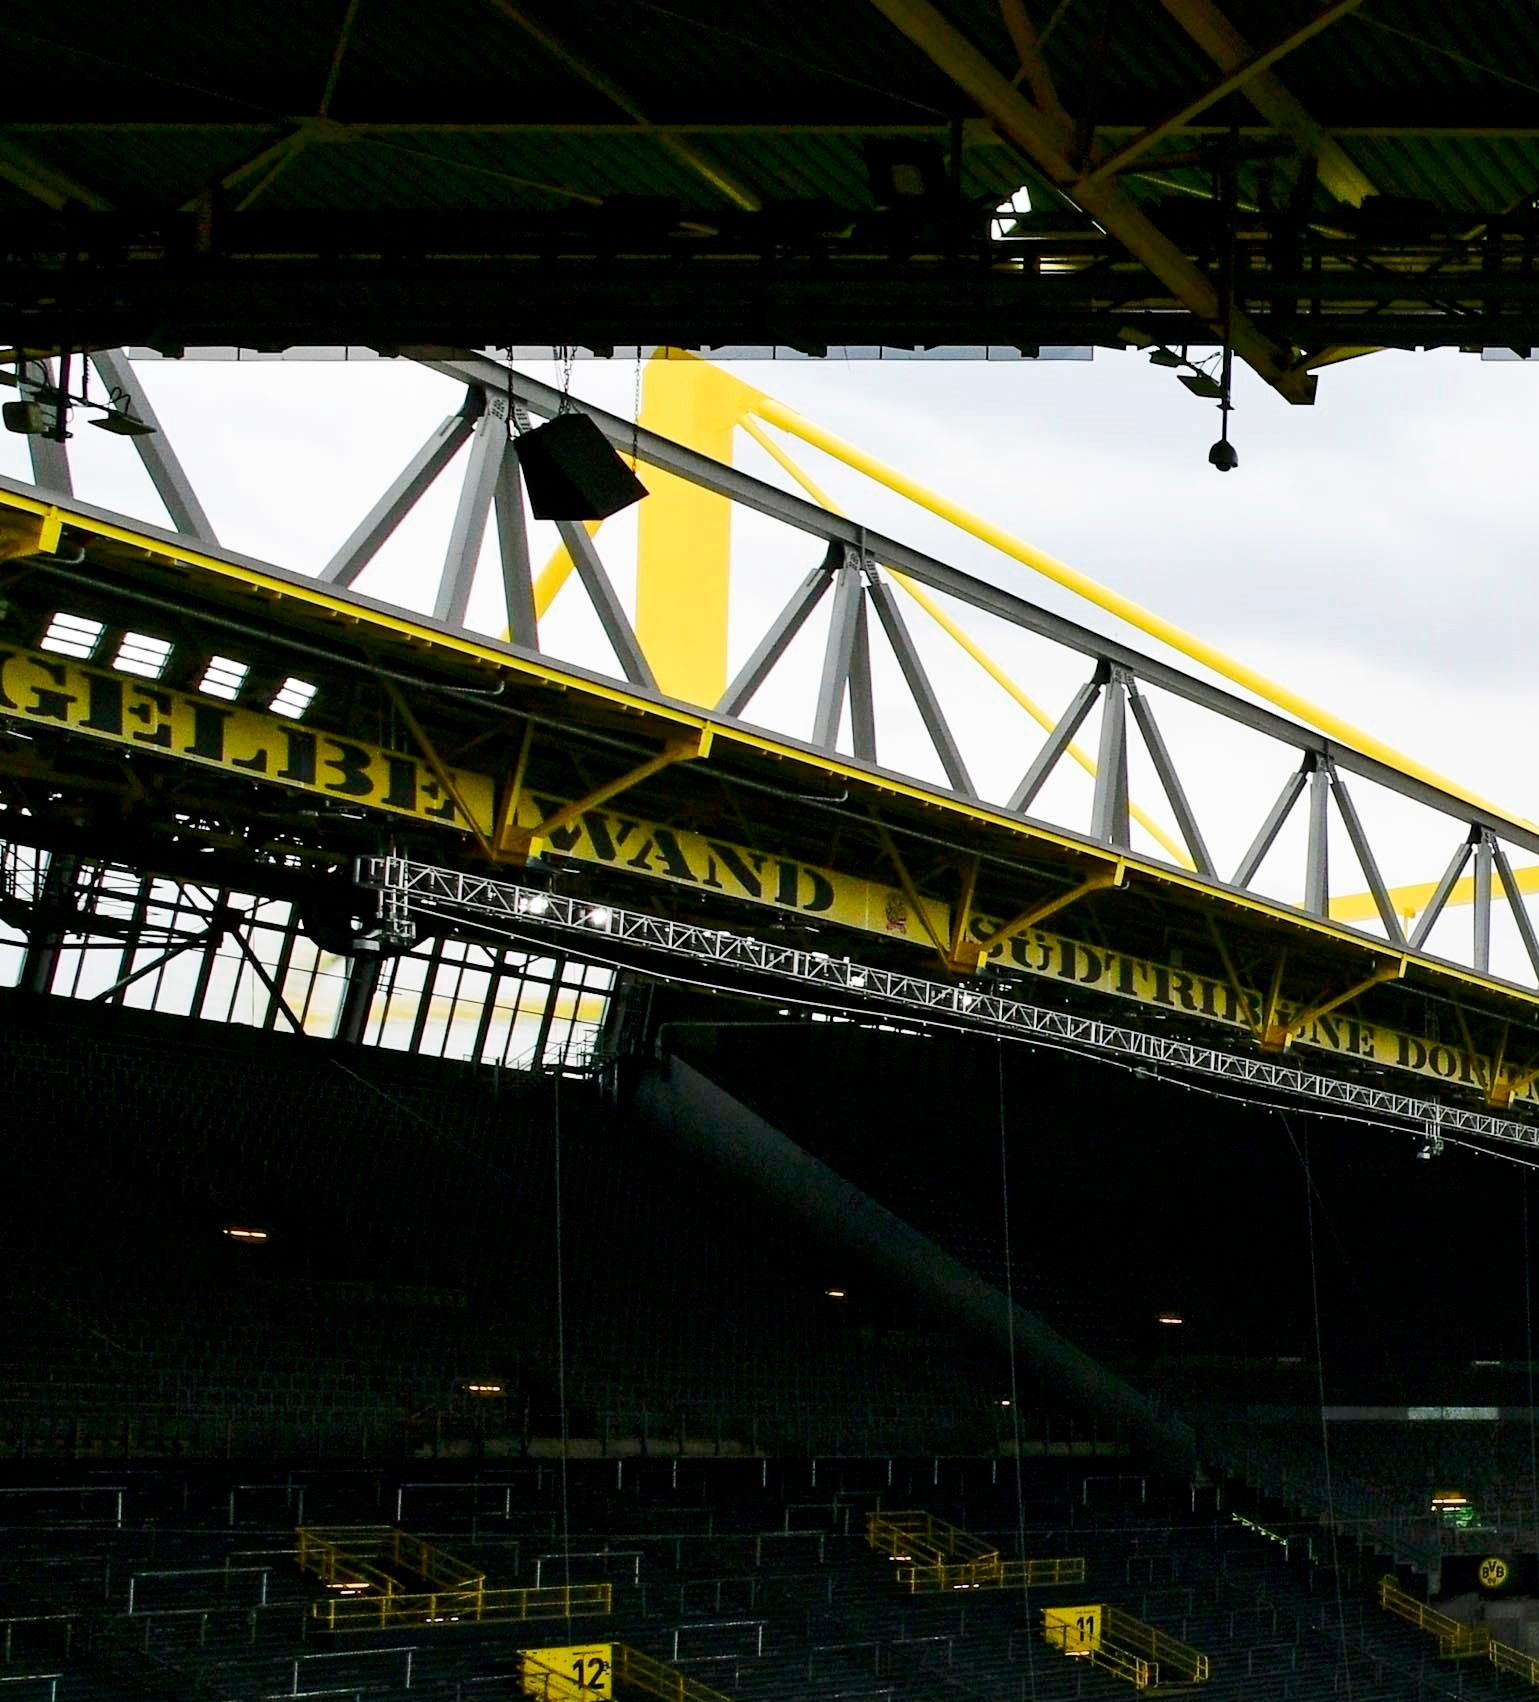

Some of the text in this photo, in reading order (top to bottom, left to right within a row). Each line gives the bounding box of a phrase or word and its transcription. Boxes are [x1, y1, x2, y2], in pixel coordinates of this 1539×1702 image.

[0, 655, 460, 822] GELBE
[1076, 1616, 1094, 1642] 11
[572, 1657, 605, 1690] 12
